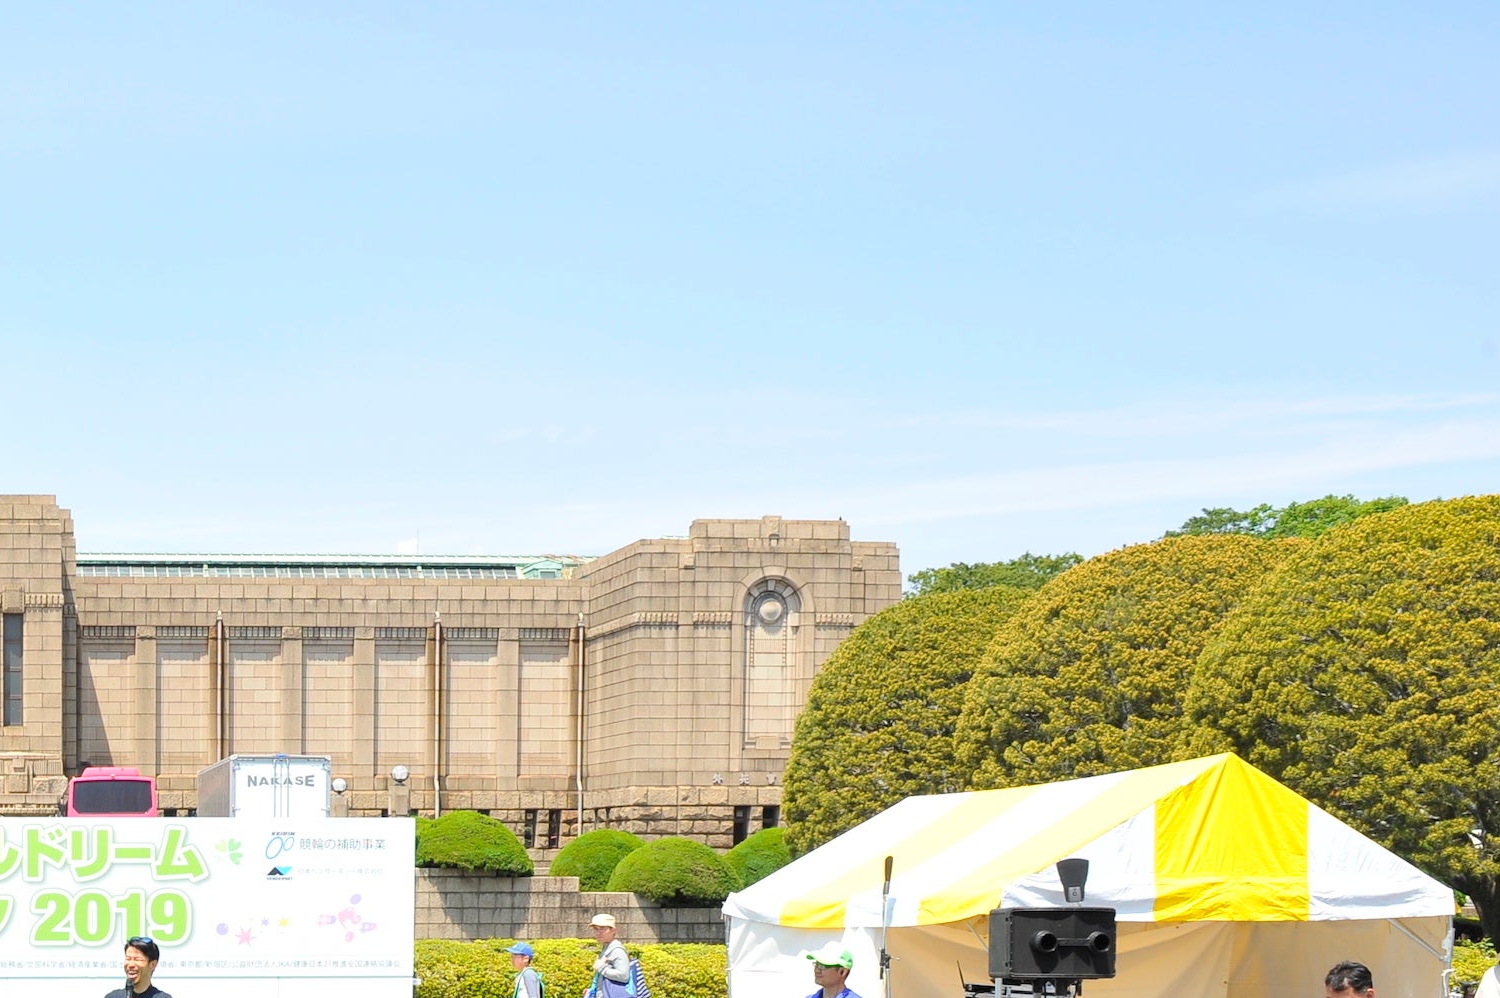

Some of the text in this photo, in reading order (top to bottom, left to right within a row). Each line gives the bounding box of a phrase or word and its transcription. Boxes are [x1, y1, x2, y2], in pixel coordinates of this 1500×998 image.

[247, 774, 315, 788] NAKASE
[299, 837, 387, 851] 競輪の補助事業
[33, 892, 189, 942] 2019
